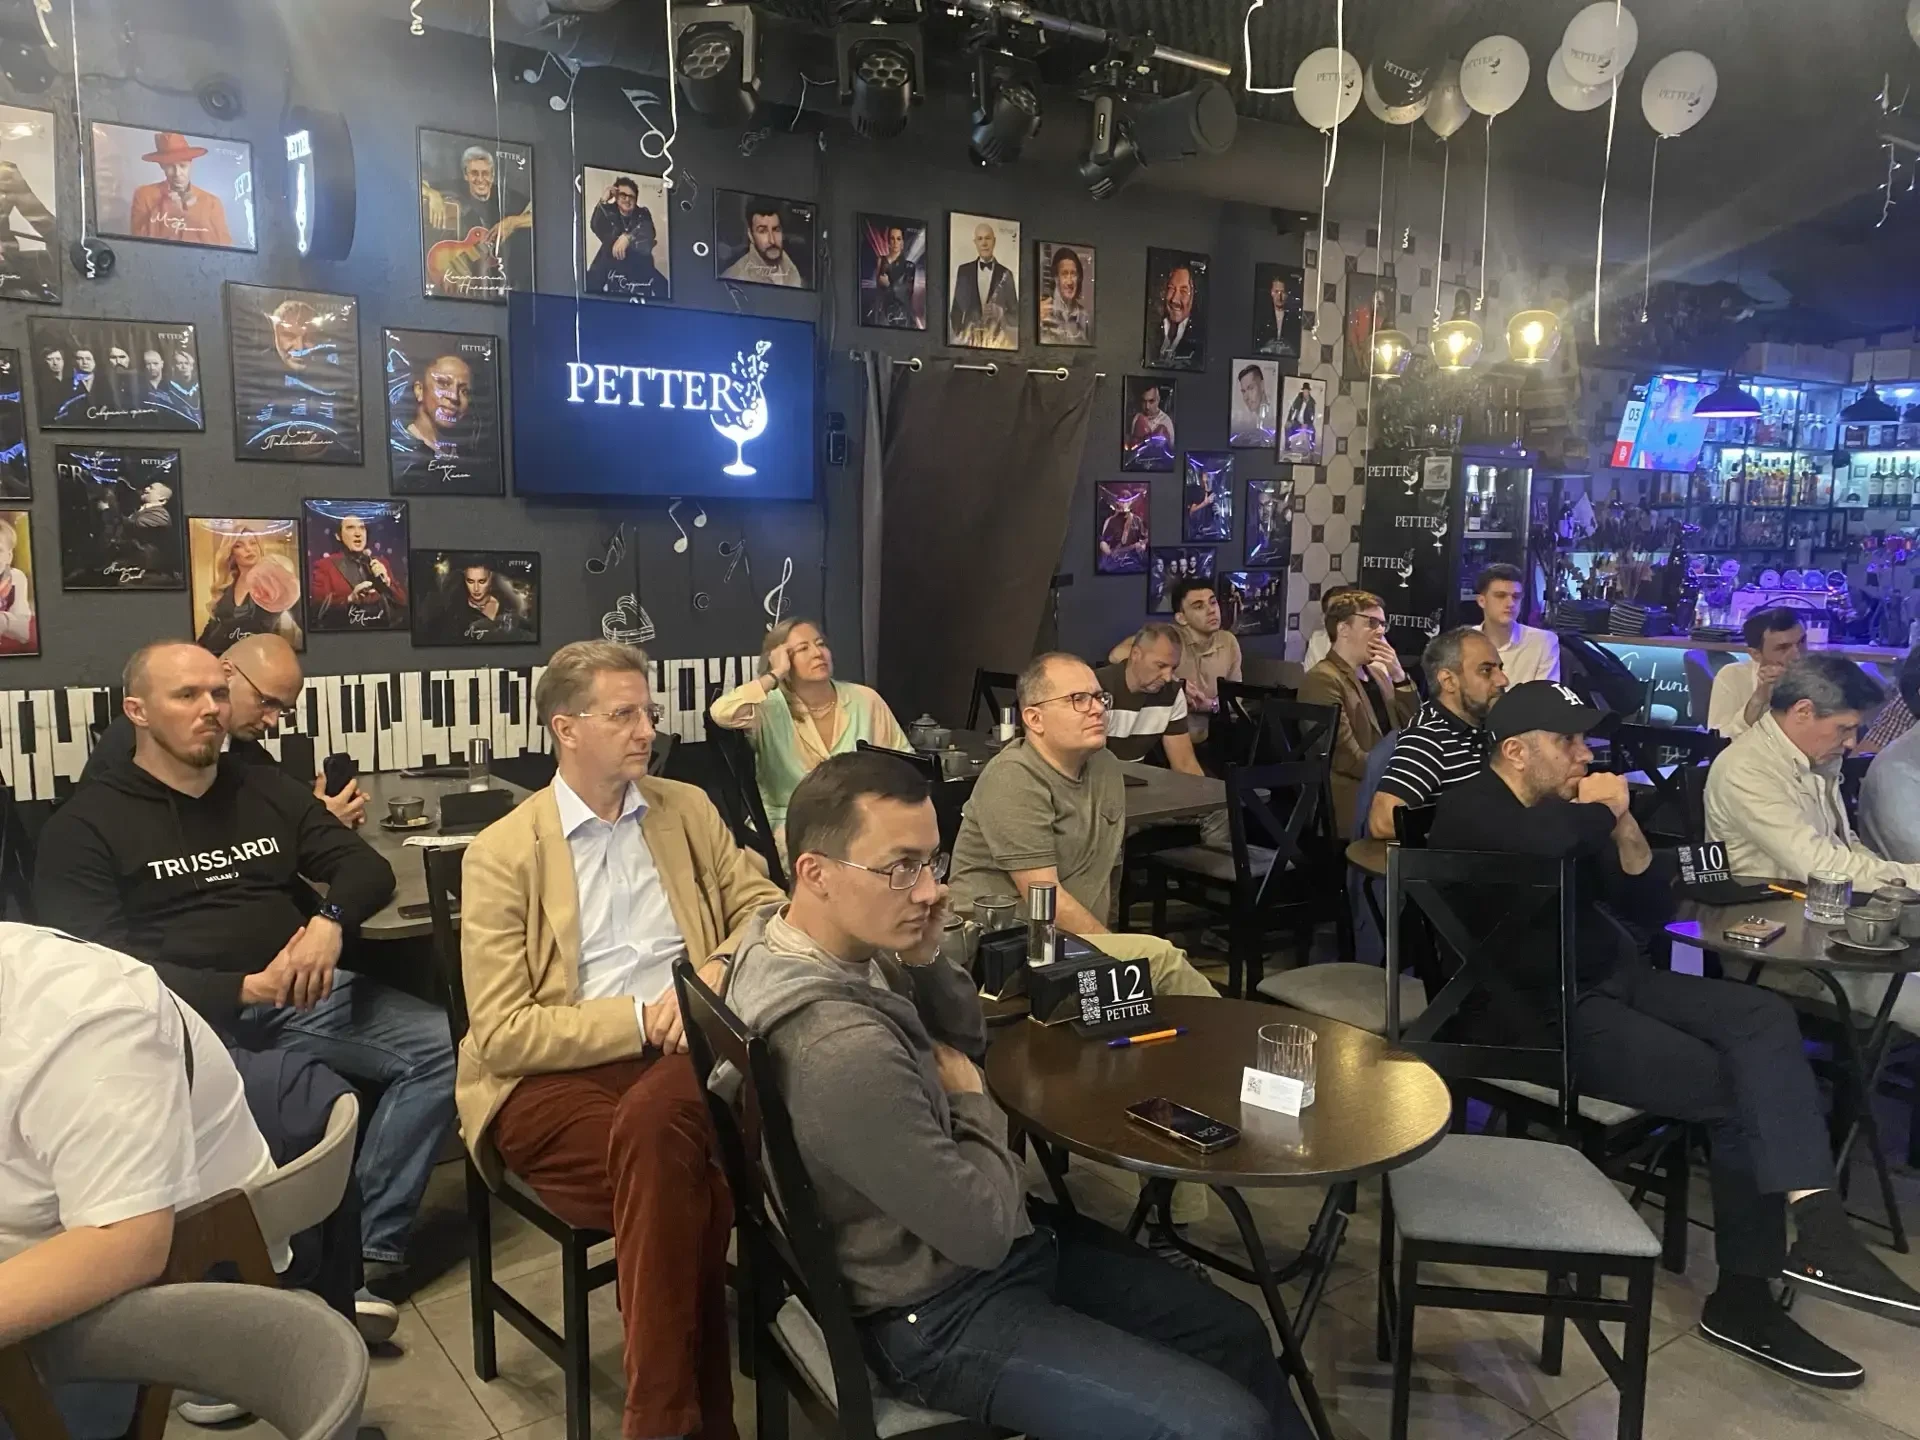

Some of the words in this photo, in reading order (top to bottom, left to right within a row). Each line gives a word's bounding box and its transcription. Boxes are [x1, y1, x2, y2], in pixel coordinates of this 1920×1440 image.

[1383, 59, 1419, 81] PETTER
[461, 344, 486, 352] PETTER
[566, 362, 743, 413] PETTER
[1367, 465, 1411, 478] PETTER
[1394, 515, 1440, 528] PETTER
[1363, 555, 1405, 569] PETTER
[1388, 613, 1432, 629] PETTER
[147, 836, 280, 880] TRUSSARDI
[1697, 844, 1723, 871] 10
[1699, 871, 1729, 884] PETTER
[1107, 964, 1145, 1003] 12
[1106, 1003, 1151, 1022] PETTER
